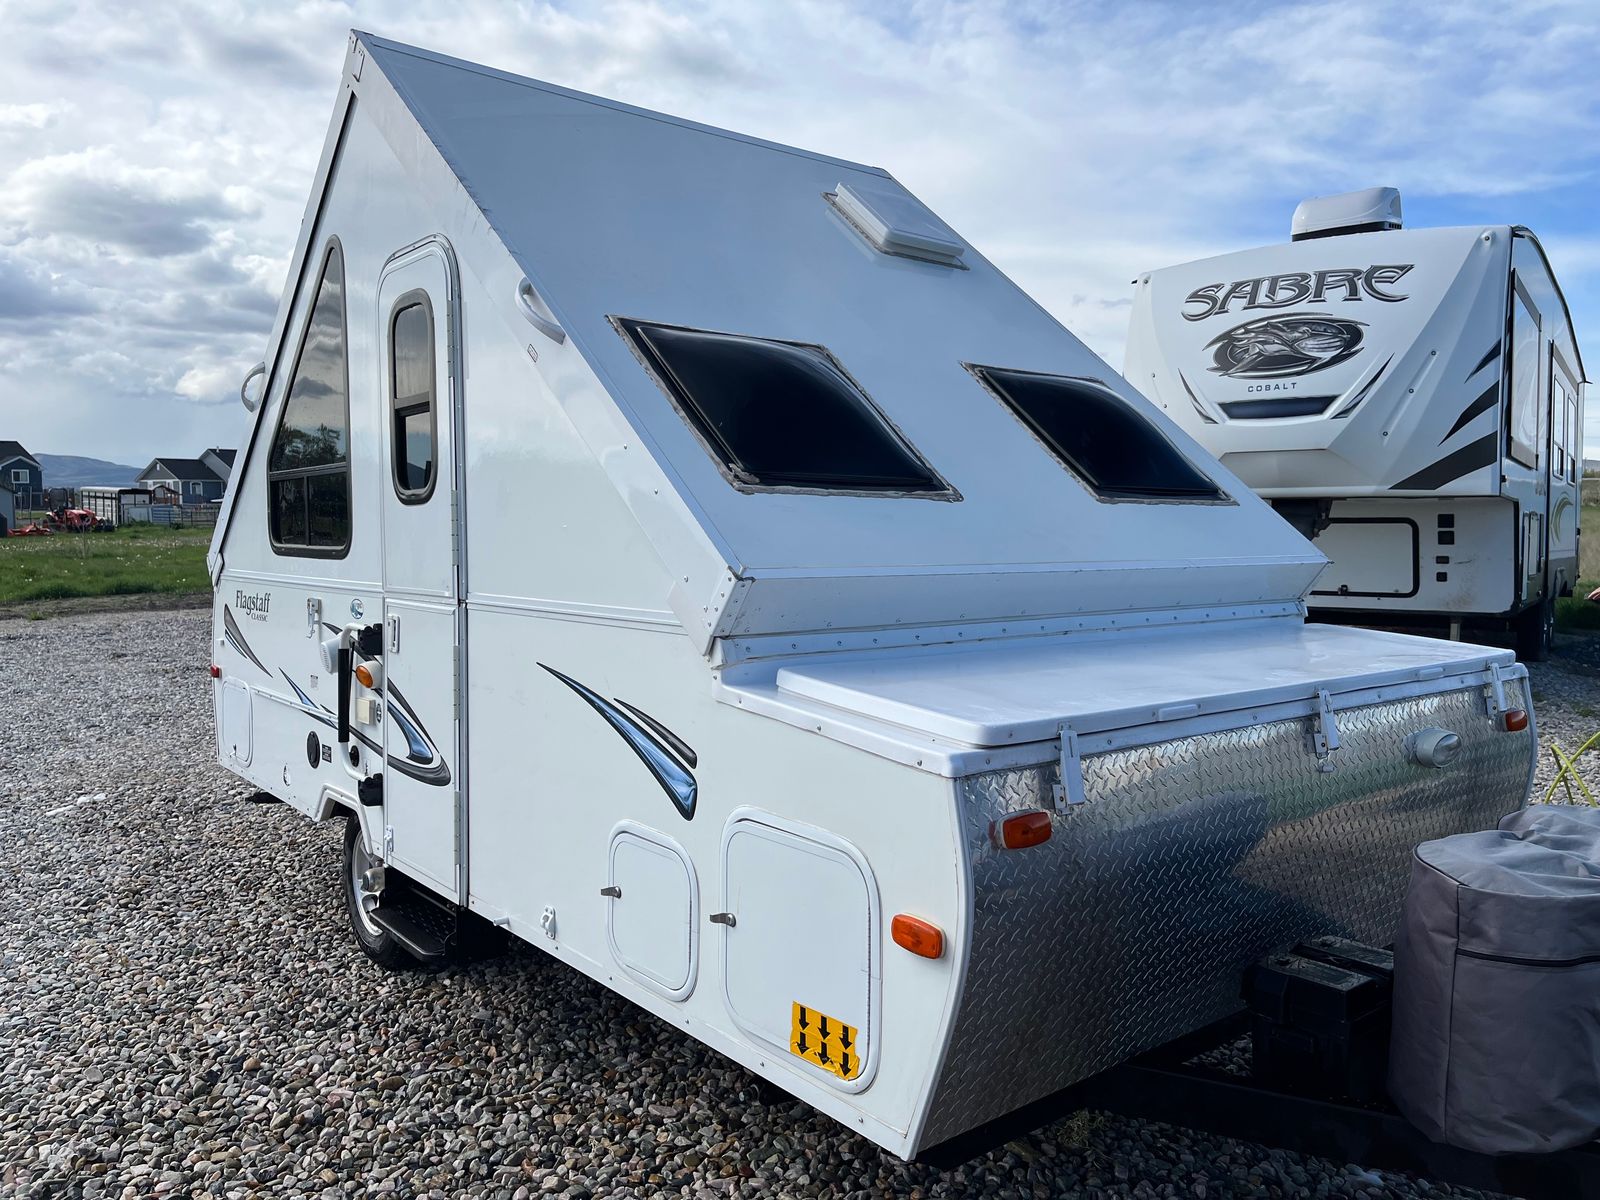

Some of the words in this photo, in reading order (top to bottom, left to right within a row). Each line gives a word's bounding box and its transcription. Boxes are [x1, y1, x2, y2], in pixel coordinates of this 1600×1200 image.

[1181, 263, 1415, 322] SABRE
[1247, 382, 1297, 393] COBALT
[235, 590, 271, 616] Flagstaff
